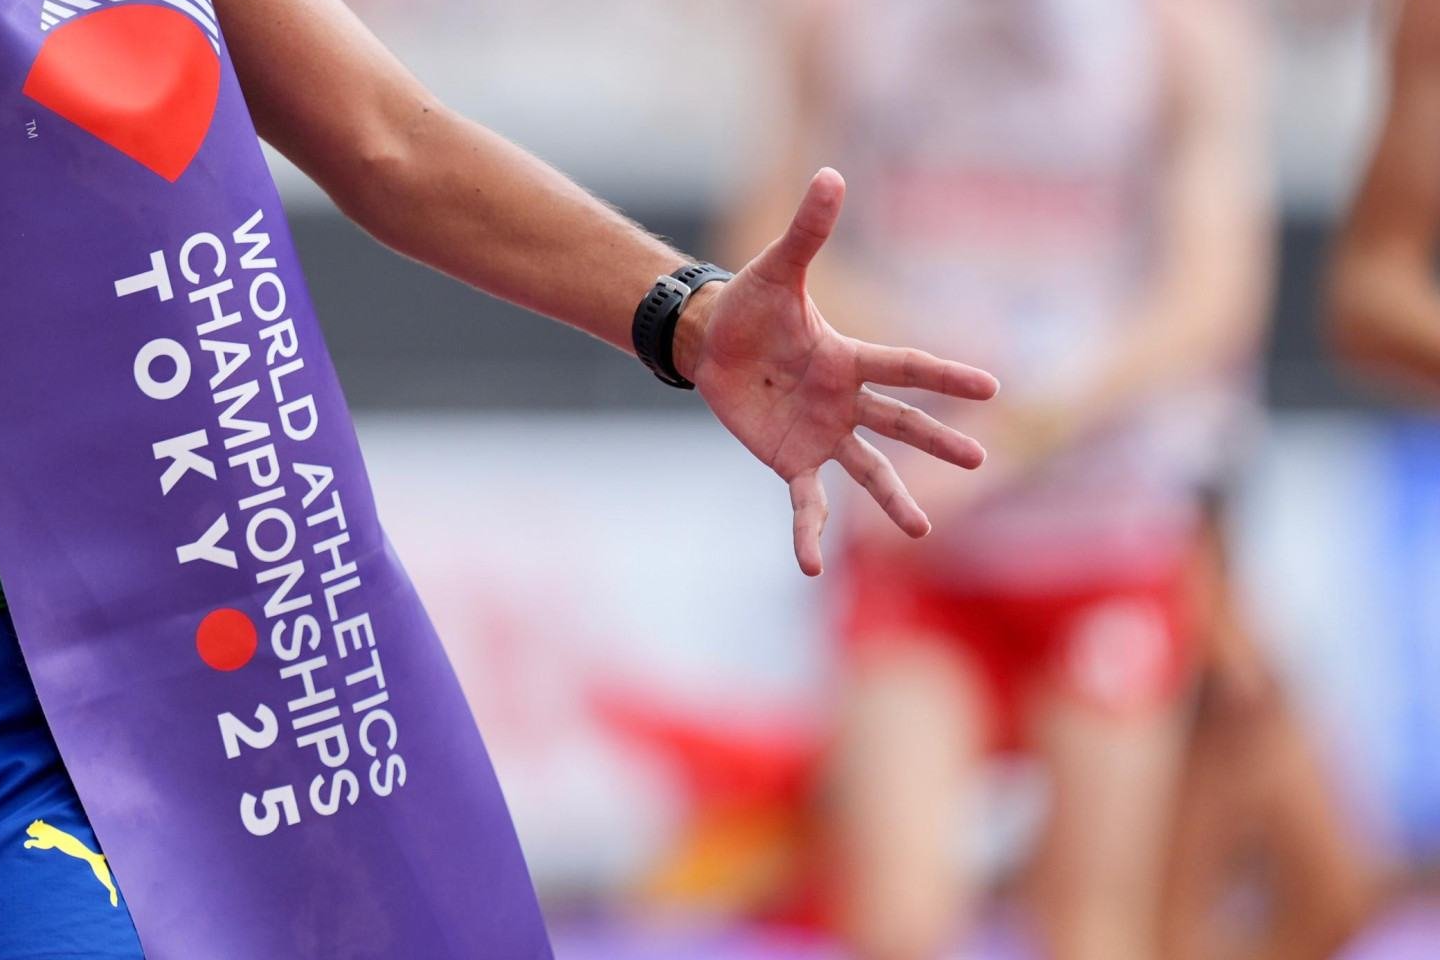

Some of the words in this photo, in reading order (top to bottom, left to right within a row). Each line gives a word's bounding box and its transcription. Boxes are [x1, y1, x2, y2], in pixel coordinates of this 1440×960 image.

[25, 119, 39, 139] TM
[179, 232, 359, 816] CHAMPIONSHIPS
[232, 209, 319, 441] WORLD
[292, 462, 407, 797] ATHLETICS
[217, 703, 301, 836] 25
